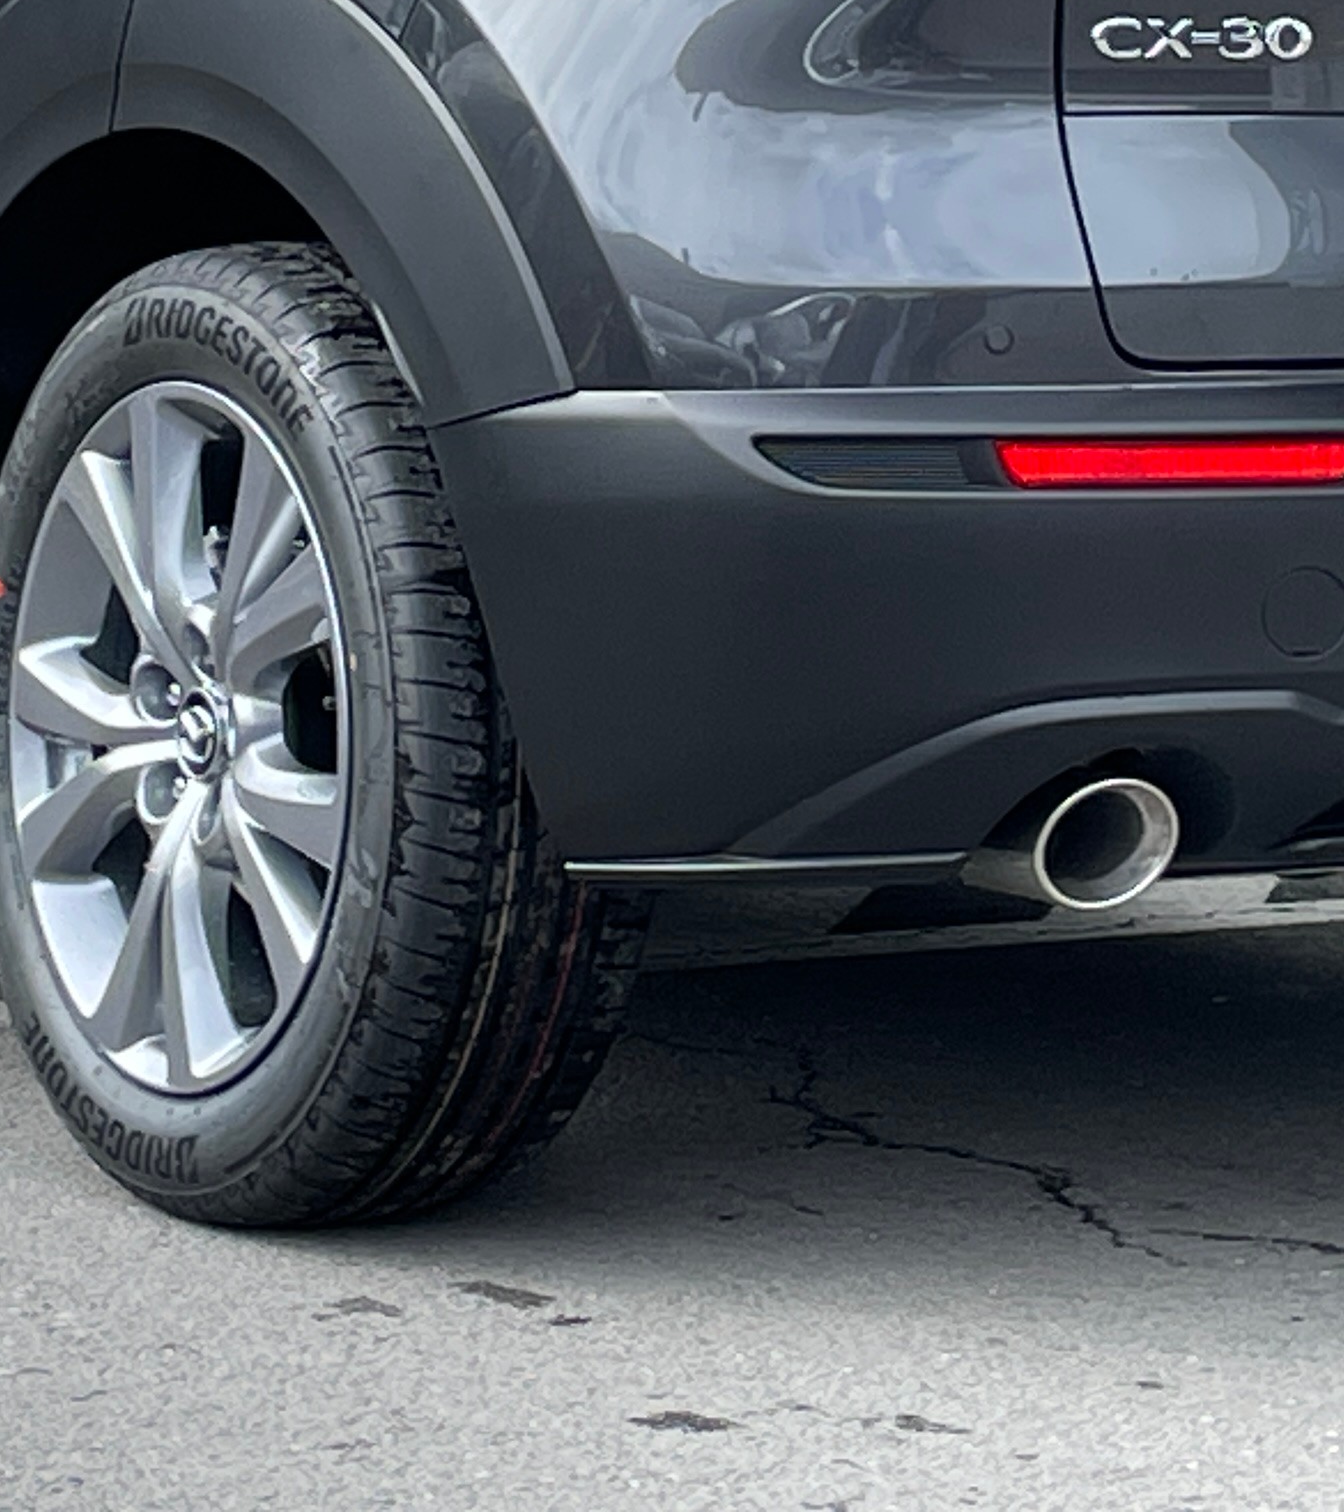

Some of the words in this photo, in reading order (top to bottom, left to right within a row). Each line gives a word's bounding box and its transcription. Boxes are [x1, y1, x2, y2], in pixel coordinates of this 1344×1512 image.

[1090, 15, 1314, 60] CX-30
[122, 296, 315, 435] BRIDGESTONE
[22, 1010, 200, 1184] BRIDGESTONE
